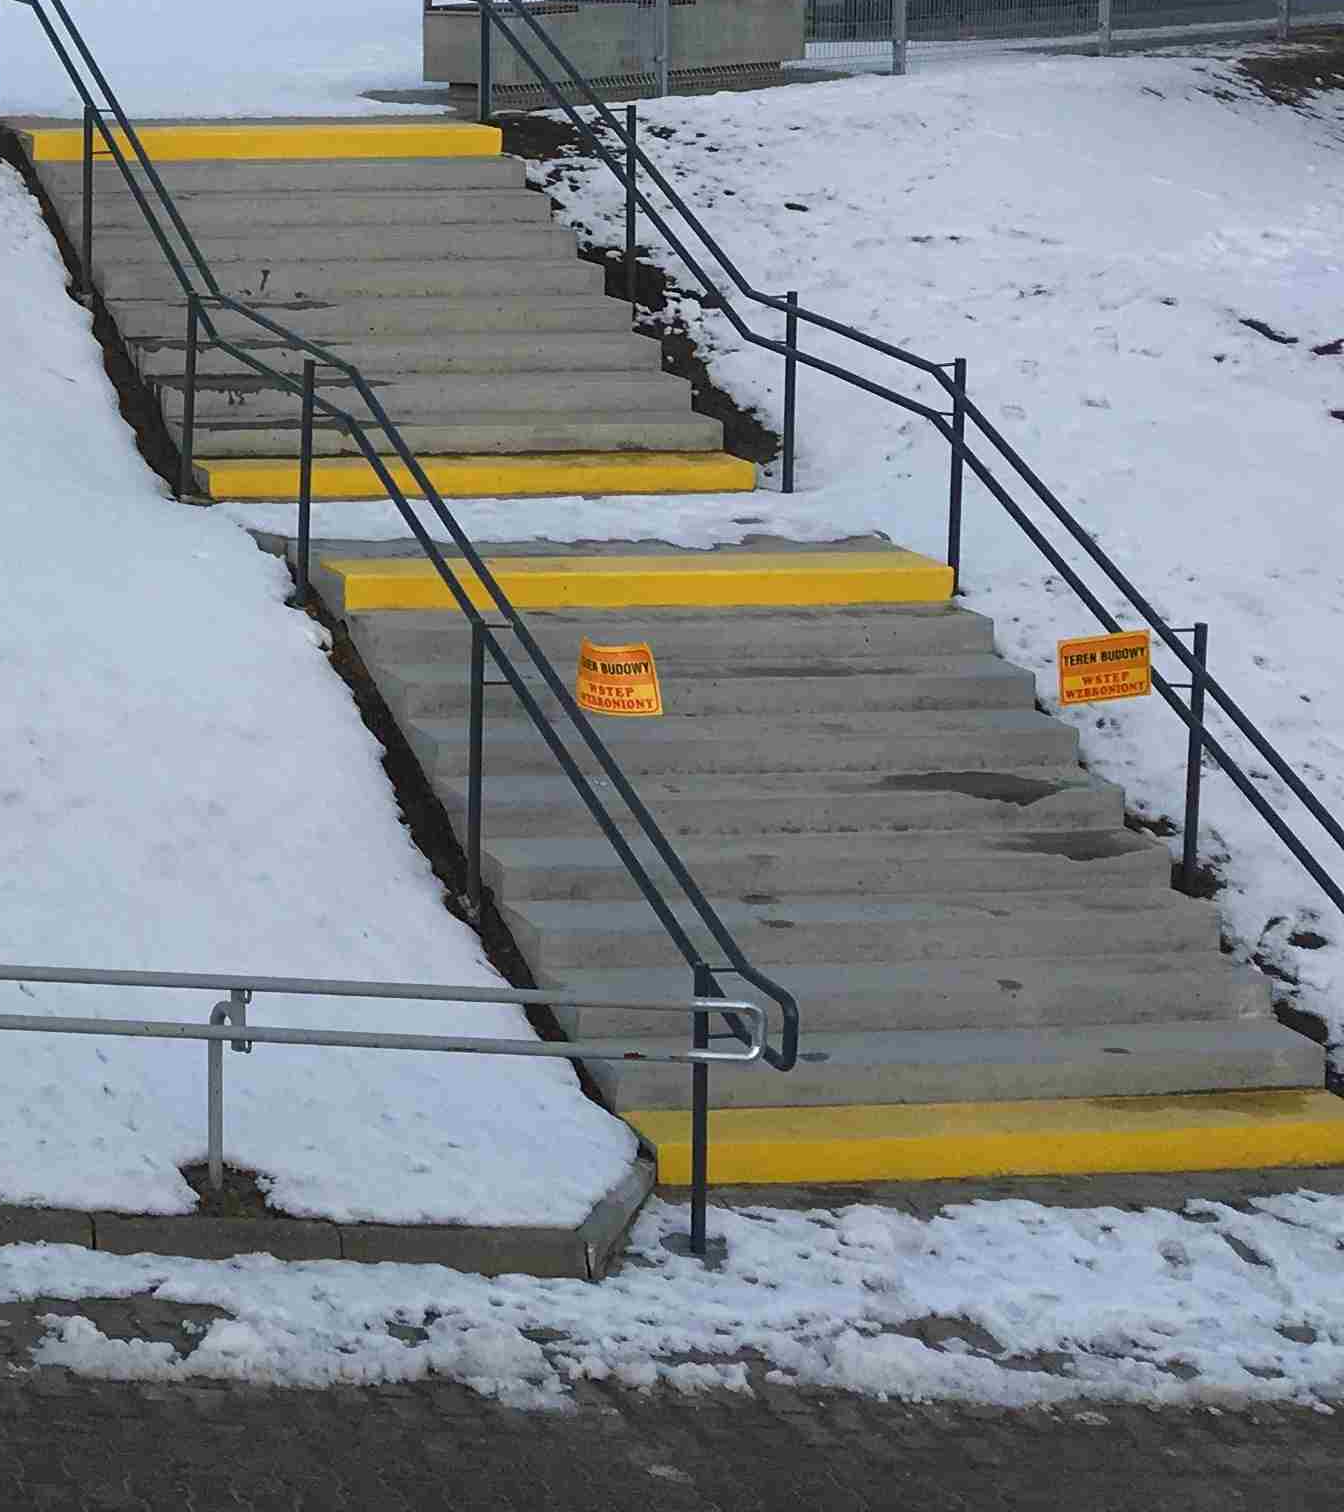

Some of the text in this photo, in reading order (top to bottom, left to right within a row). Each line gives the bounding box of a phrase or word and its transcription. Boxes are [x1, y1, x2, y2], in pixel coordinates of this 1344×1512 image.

[1064, 647, 1145, 666] TEREN BUDOWY
[601, 661, 649, 675] BUDOWY
